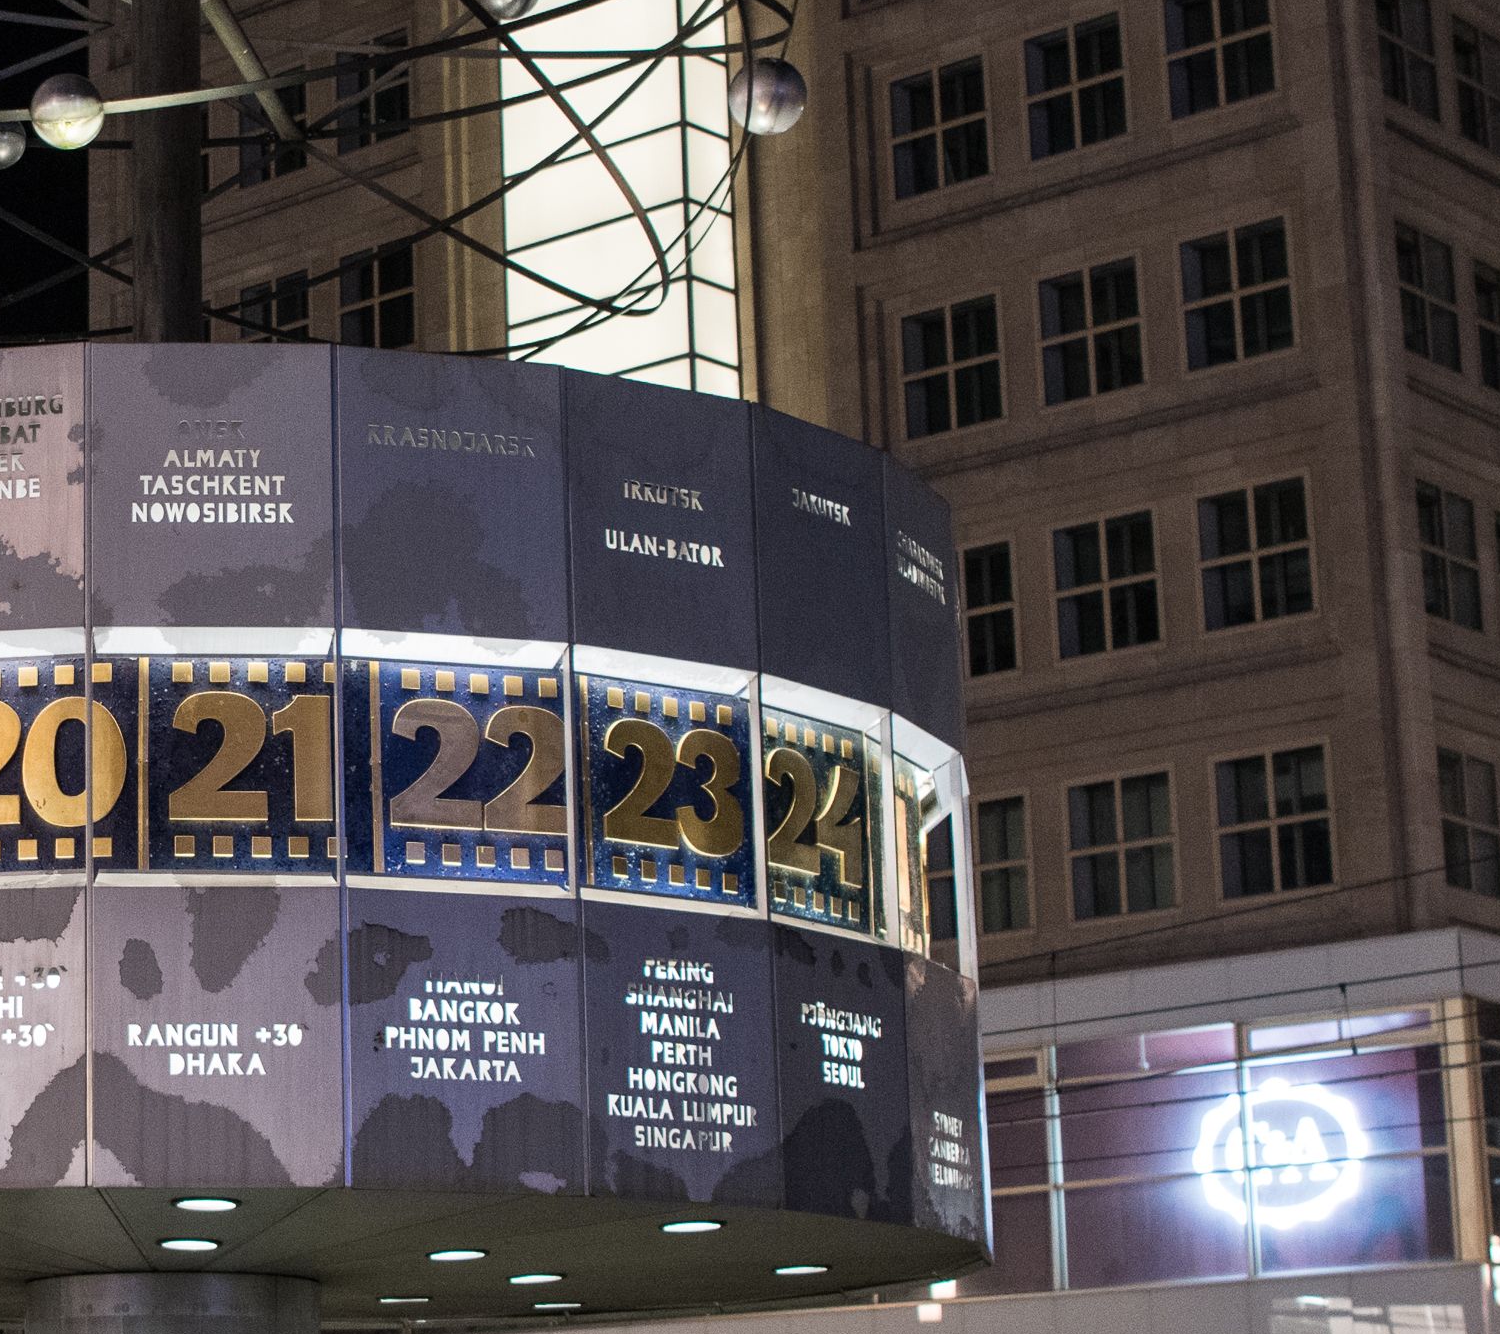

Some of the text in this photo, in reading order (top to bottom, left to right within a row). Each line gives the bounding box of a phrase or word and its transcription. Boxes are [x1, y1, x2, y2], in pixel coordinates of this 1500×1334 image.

[368, 423, 535, 457] KRASNOJARSK
[164, 449, 261, 468] ALMATY
[140, 474, 286, 496] TASCHKENT
[623, 478, 703, 512] IRKUTSK
[131, 502, 295, 524] NOWOSIBIRSK
[791, 487, 851, 527] JAKUTSK
[605, 528, 725, 568] ULAN-BATOR
[168, 691, 334, 822] 21
[390, 698, 569, 835] 22
[603, 718, 743, 857] 23
[765, 747, 863, 889] 24
[643, 957, 715, 984] PEKING
[408, 998, 521, 1026] BANGKOK
[625, 983, 734, 1014] SHANGHAI
[127, 1023, 239, 1047] RANGUN
[385, 1025, 547, 1056] PHNOM PENH
[640, 1010, 721, 1041] MANILA
[651, 1040, 713, 1068] PERTH
[821, 1033, 864, 1062] TOKYO
[169, 1053, 267, 1076] DHAKA
[410, 1056, 523, 1083] JAKARTA
[822, 1061, 866, 1089] SEOUL
[627, 1066, 738, 1099] HONGKONG
[608, 1094, 758, 1128] KUALA LUMPUR
[933, 1111, 964, 1139] SYDNEY
[634, 1124, 734, 1154] SINGAPUR
[1225, 1116, 1338, 1186] C&A
